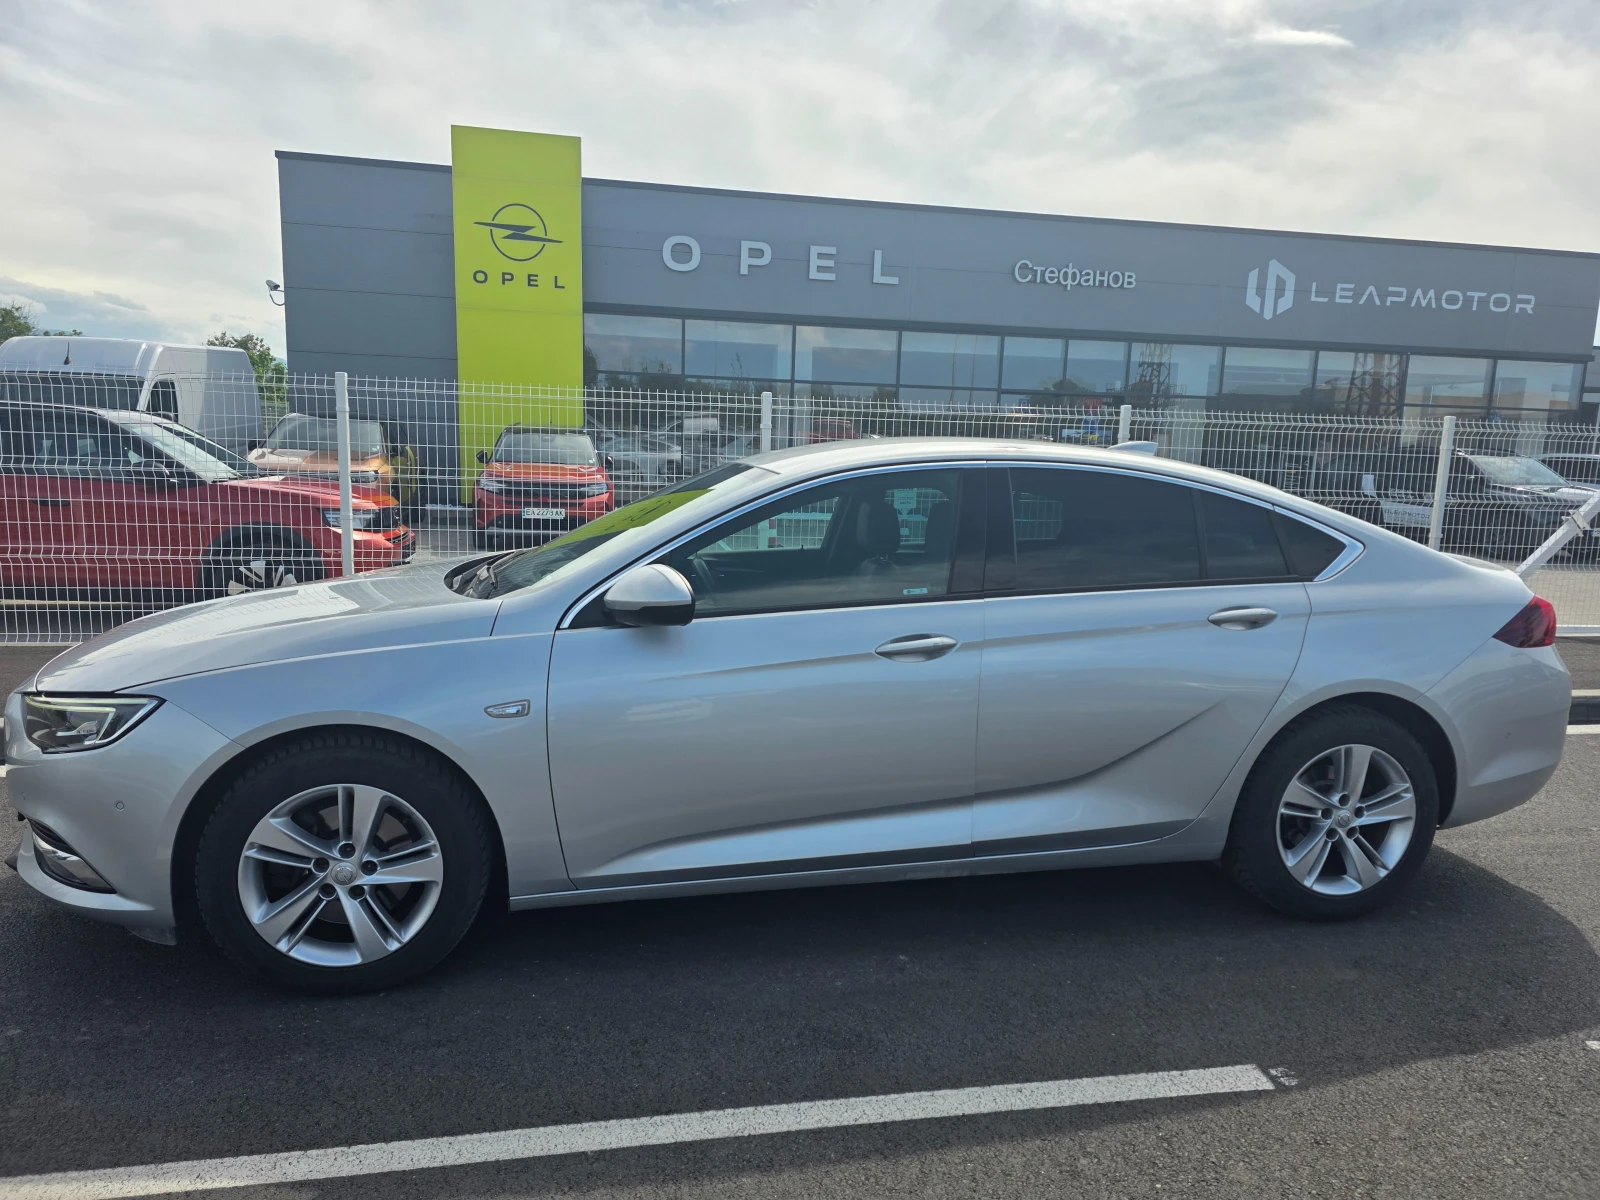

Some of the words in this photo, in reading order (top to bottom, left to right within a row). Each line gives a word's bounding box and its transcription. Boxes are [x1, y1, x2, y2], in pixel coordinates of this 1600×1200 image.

[662, 235, 899, 285] OPEL
[1014, 259, 1137, 291] Стефанов
[472, 269, 566, 290] OPEL
[1310, 281, 1536, 315] LEAPMOTOR
